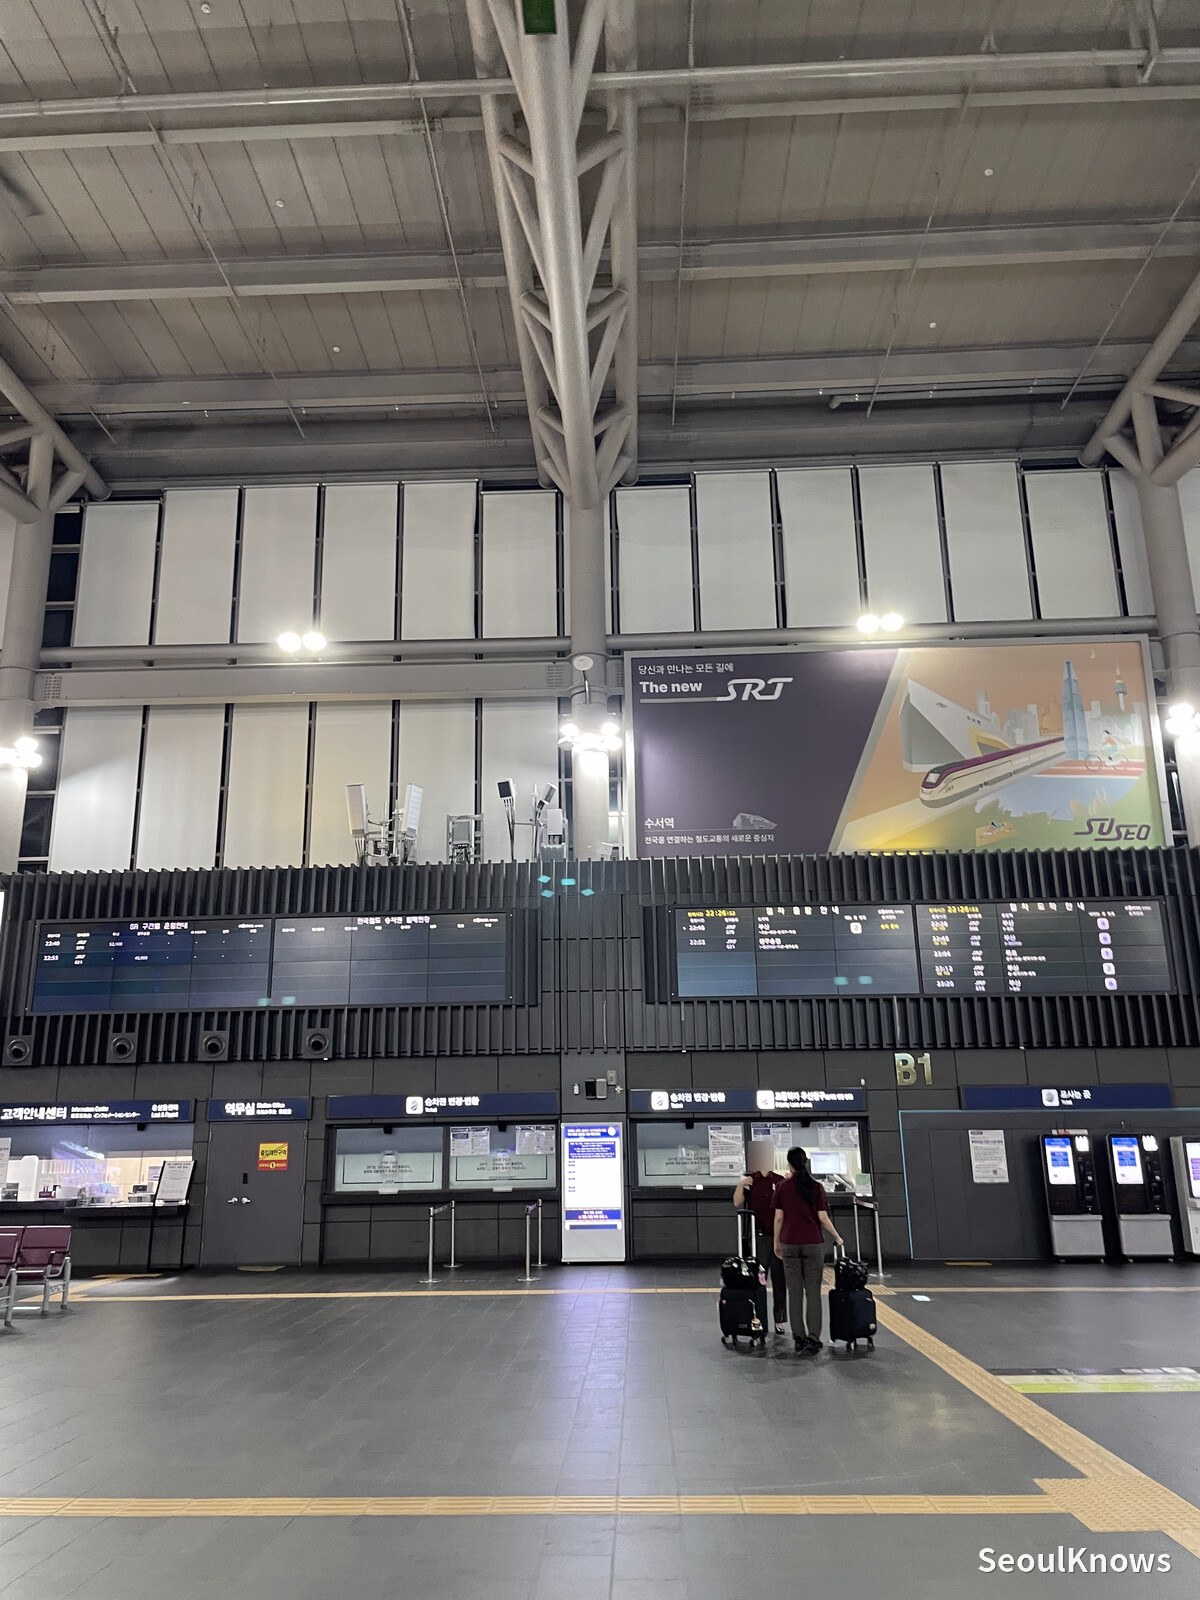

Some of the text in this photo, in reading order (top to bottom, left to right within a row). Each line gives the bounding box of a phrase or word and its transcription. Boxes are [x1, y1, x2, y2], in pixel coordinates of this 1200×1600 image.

[638, 662, 734, 675] 당신과 만나는 모든 길에
[639, 681, 703, 693] The new
[716, 677, 794, 702] SRT
[644, 817, 675, 829] 수서역
[894, 1052, 933, 1086] B1
[424, 1097, 447, 1106] 승차권
[670, 1092, 693, 1102] 승차권
[1, 1106, 68, 1120] 고객안내센터
[224, 1102, 256, 1116] 역무실
